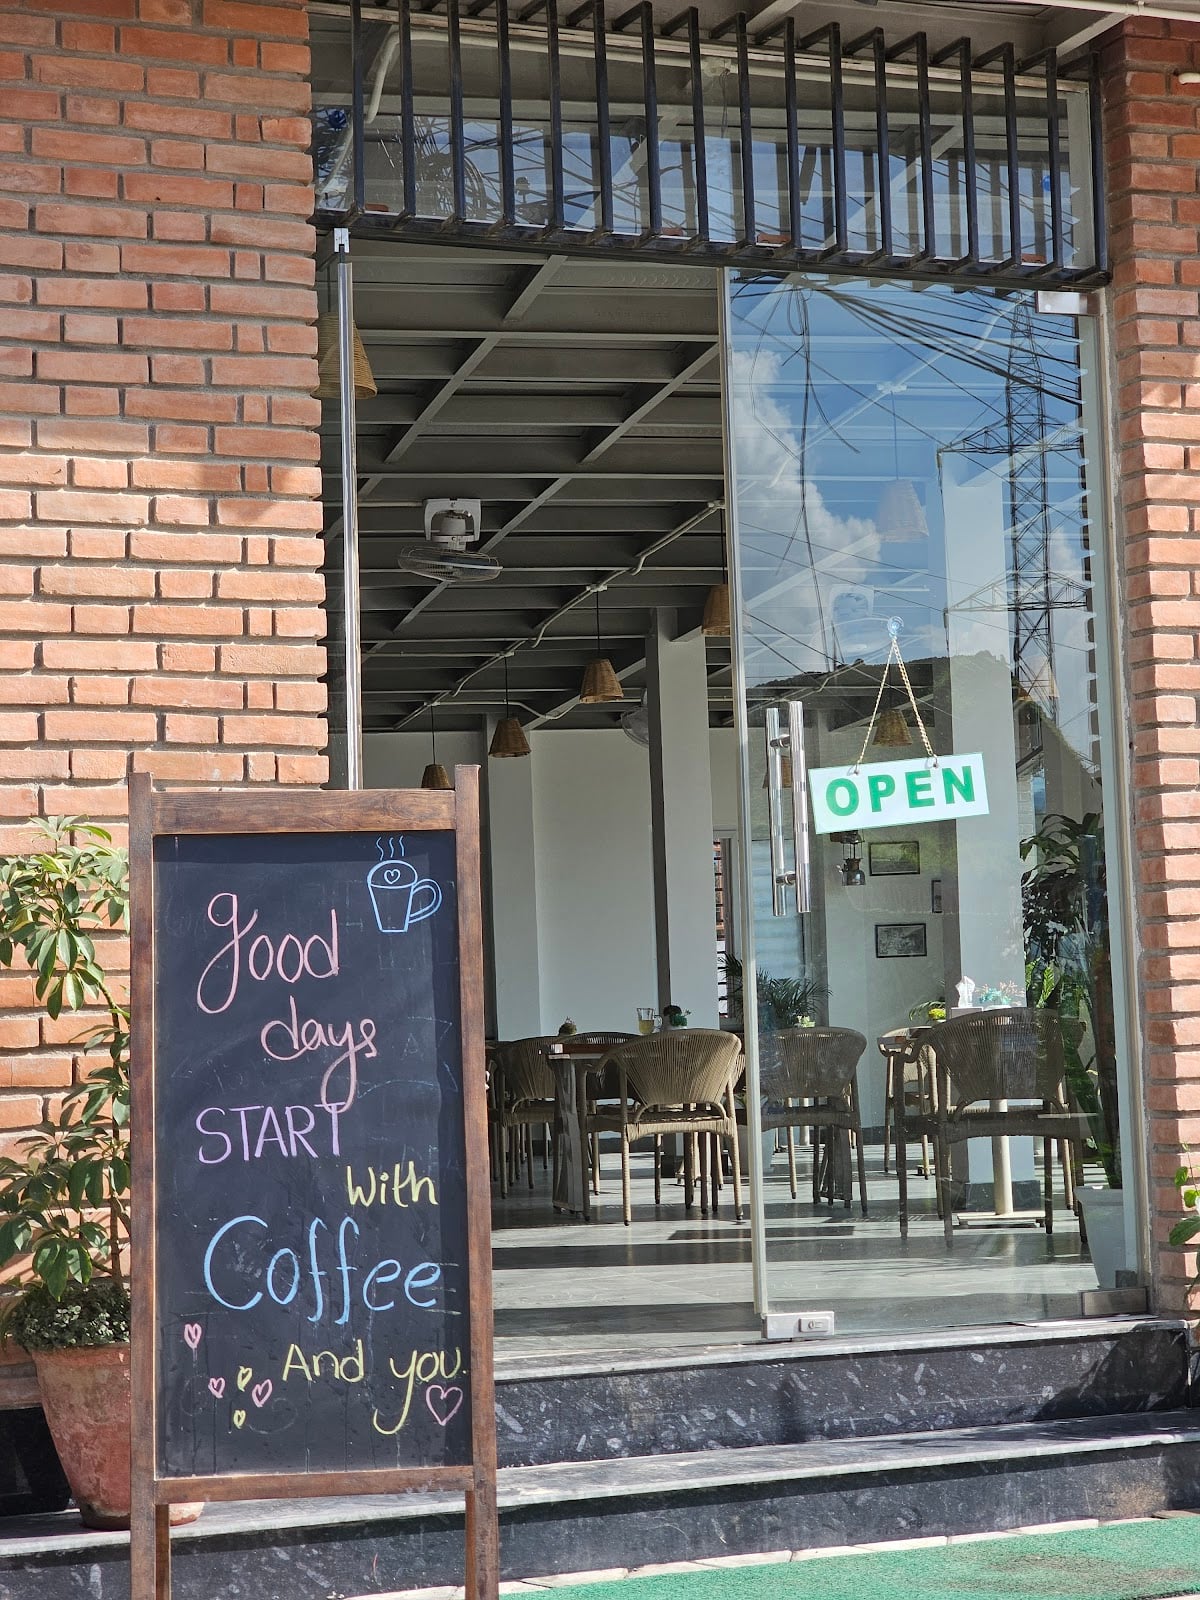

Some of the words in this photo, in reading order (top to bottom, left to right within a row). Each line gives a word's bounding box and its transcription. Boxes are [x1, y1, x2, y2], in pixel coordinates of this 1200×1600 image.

[825, 765, 976, 817] OPEN
[196, 892, 340, 1014] good
[260, 995, 377, 1114] days
[195, 1100, 347, 1165] START
[203, 1214, 441, 1325] Coffee
[281, 1338, 365, 1383] And
